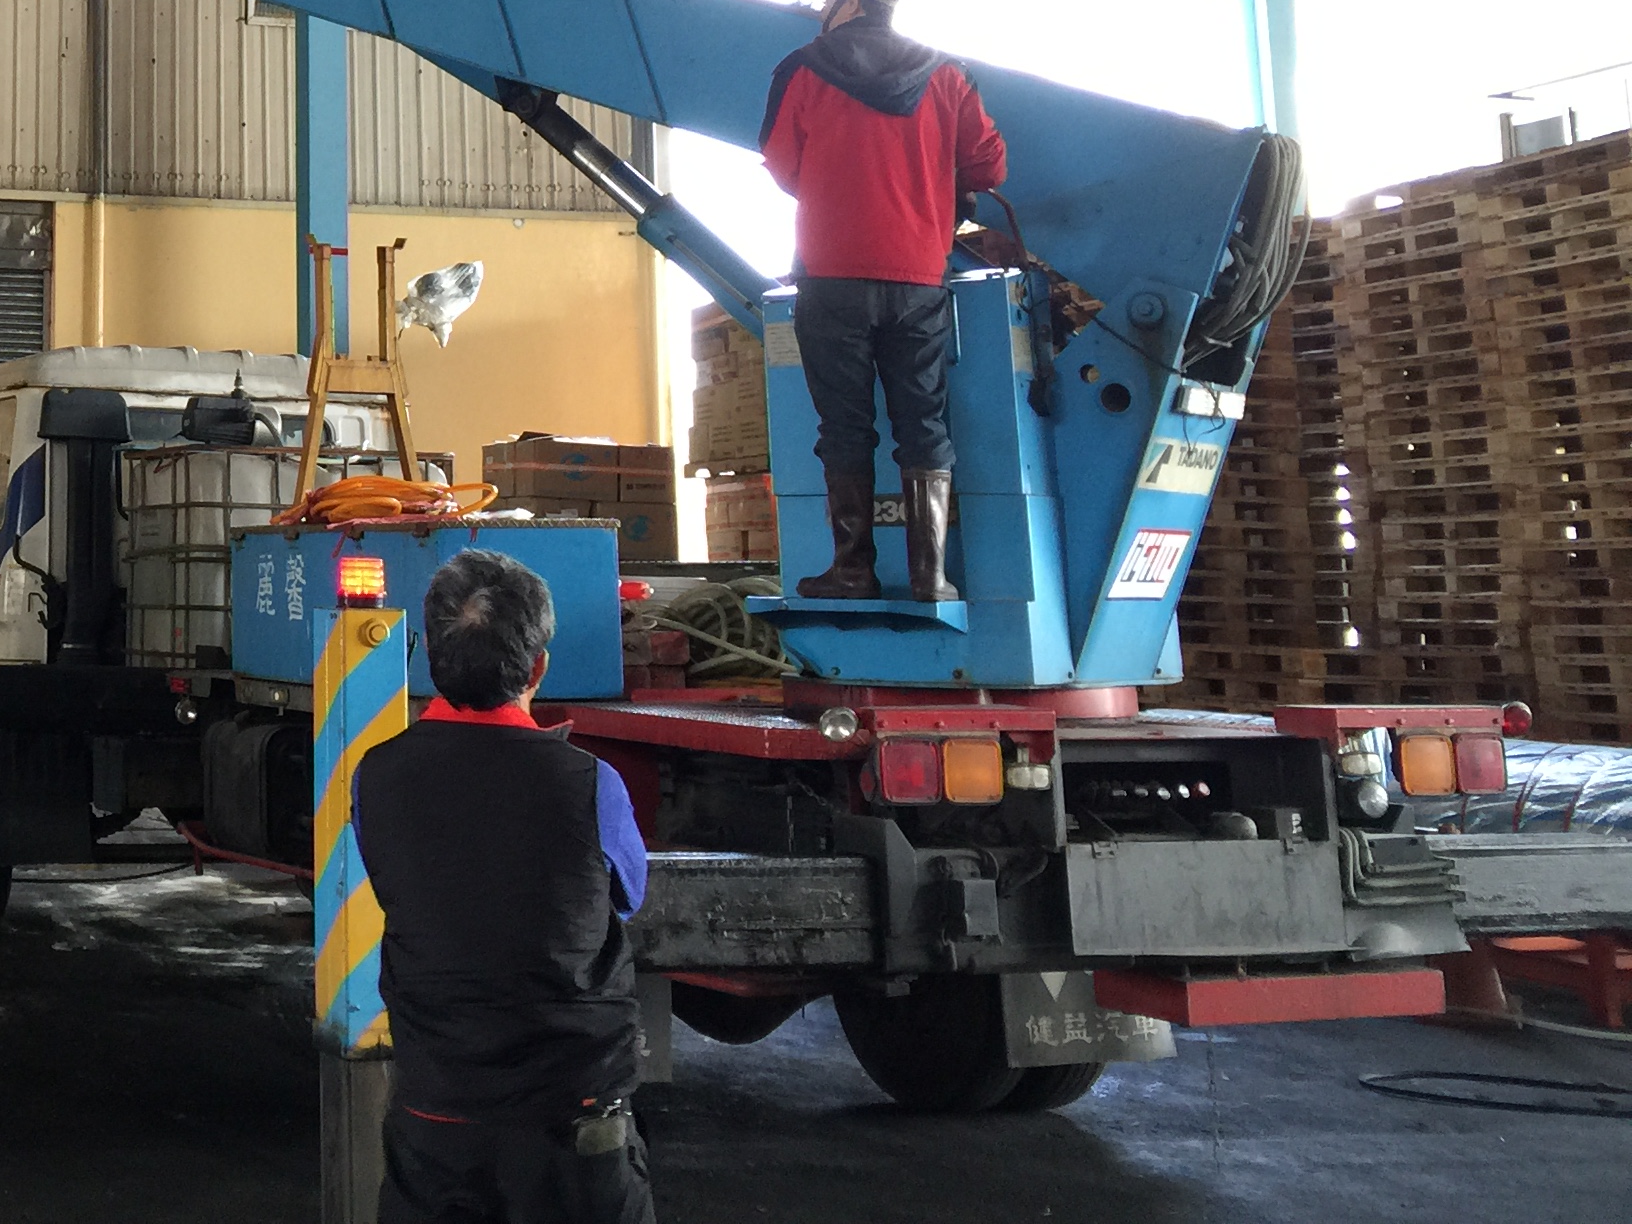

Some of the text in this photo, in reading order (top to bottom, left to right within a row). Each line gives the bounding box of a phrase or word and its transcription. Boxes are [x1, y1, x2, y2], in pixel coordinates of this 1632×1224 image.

[1178, 447, 1219, 470] TADANO
[1025, 1011, 1159, 1047] 健益汽車
